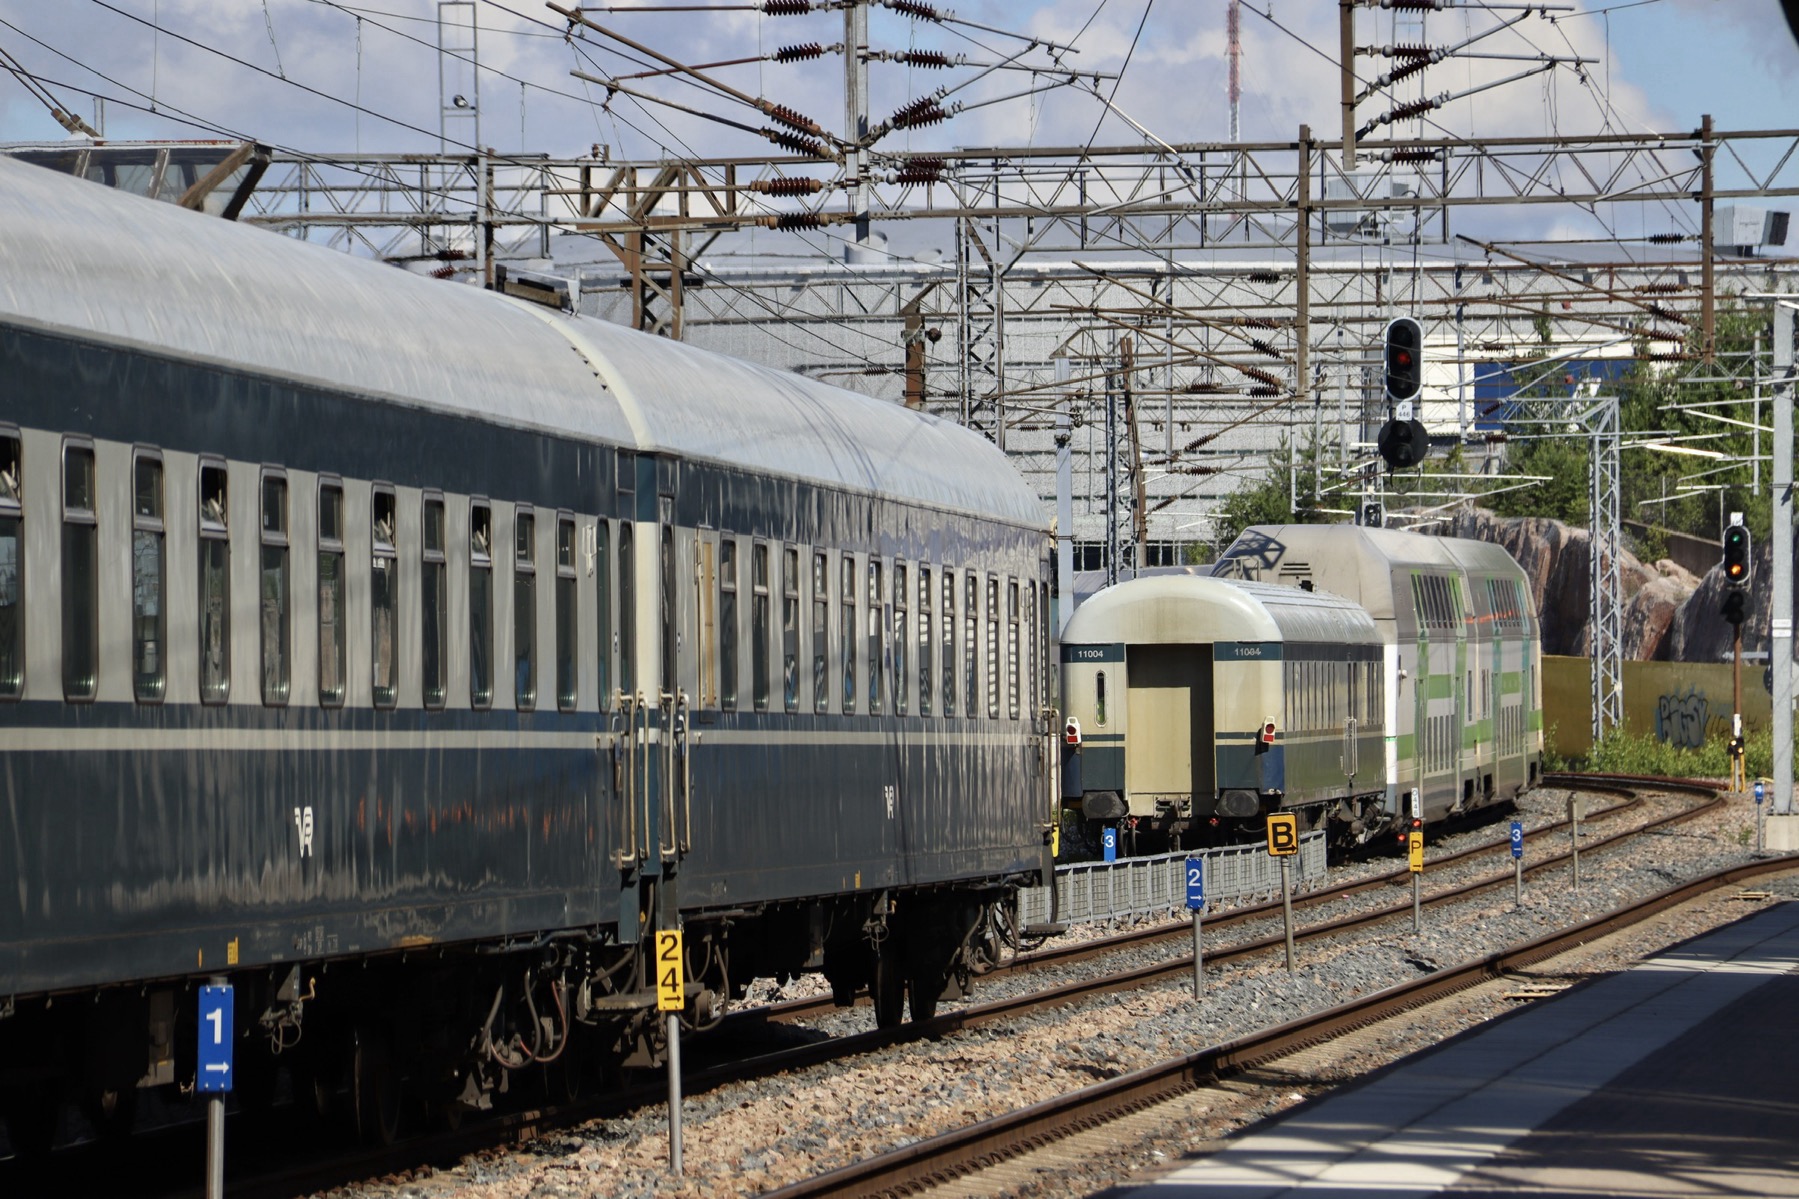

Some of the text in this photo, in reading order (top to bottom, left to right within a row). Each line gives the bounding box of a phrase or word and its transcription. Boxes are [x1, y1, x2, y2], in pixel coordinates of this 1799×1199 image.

[1078, 650, 1103, 658] 11004
[884, 785, 894, 819] VR
[294, 806, 313, 858] VR
[1272, 822, 1293, 848] B
[1512, 829, 1521, 842] 3
[1105, 835, 1114, 848] 3
[1411, 840, 1421, 854] P
[1188, 869, 1201, 886] 2
[206, 1007, 222, 1044] 1
